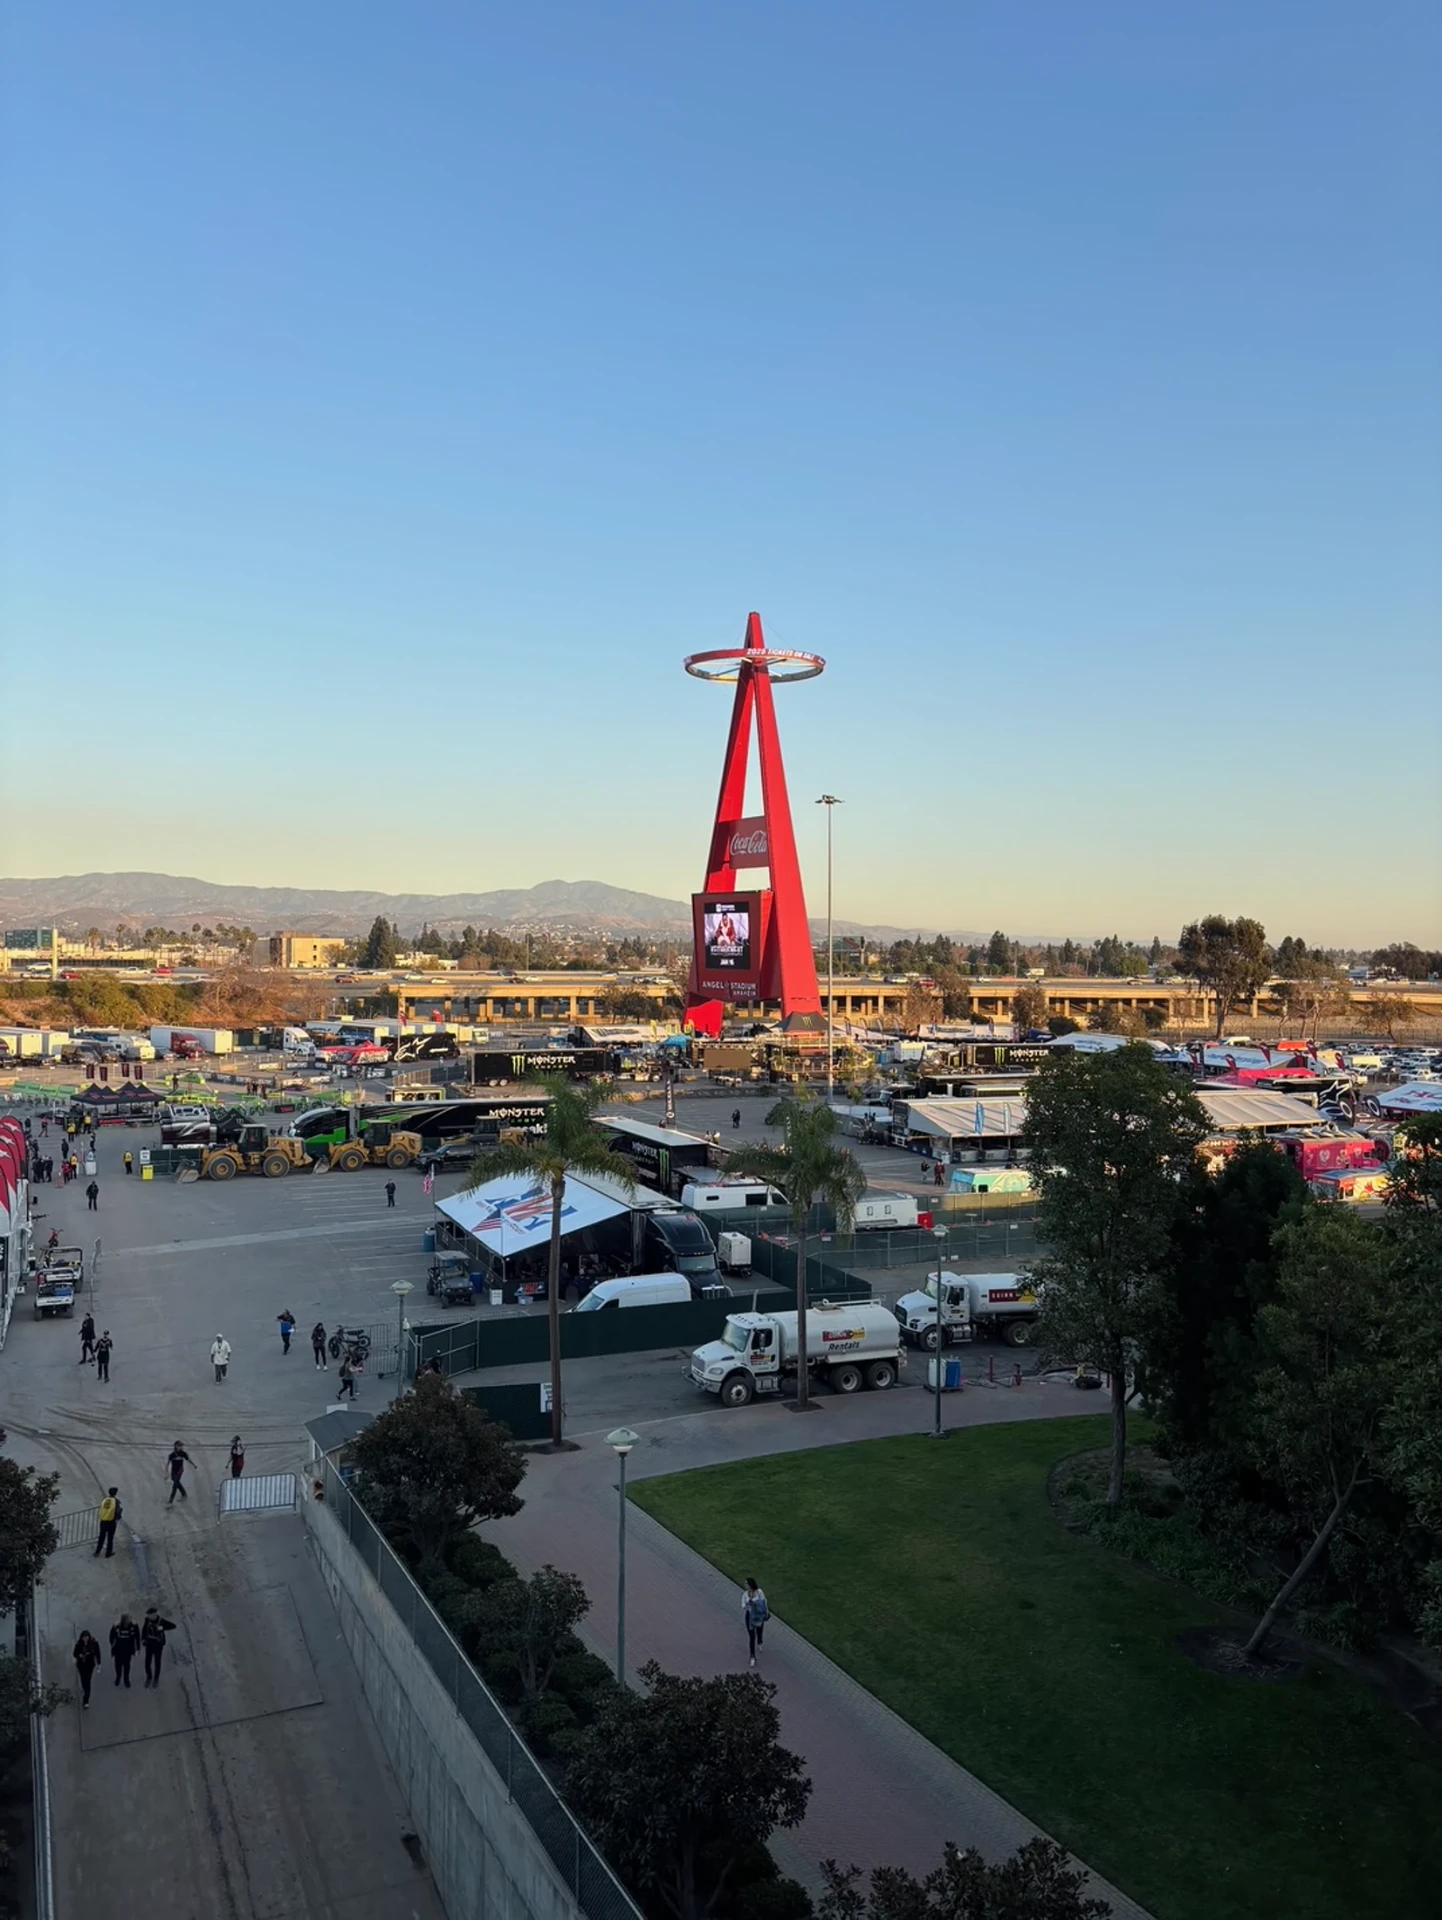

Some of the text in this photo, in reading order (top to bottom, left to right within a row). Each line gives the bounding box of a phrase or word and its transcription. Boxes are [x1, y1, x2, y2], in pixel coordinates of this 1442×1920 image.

[767, 648, 793, 656] TICKETS
[702, 981, 756, 990] ANGEL STADIUM
[1009, 1048, 1049, 1057] MONSTER
[527, 1055, 576, 1065] MONSTER
[489, 1107, 545, 1118] MONSTER
[828, 1341, 860, 1351] Rentals
